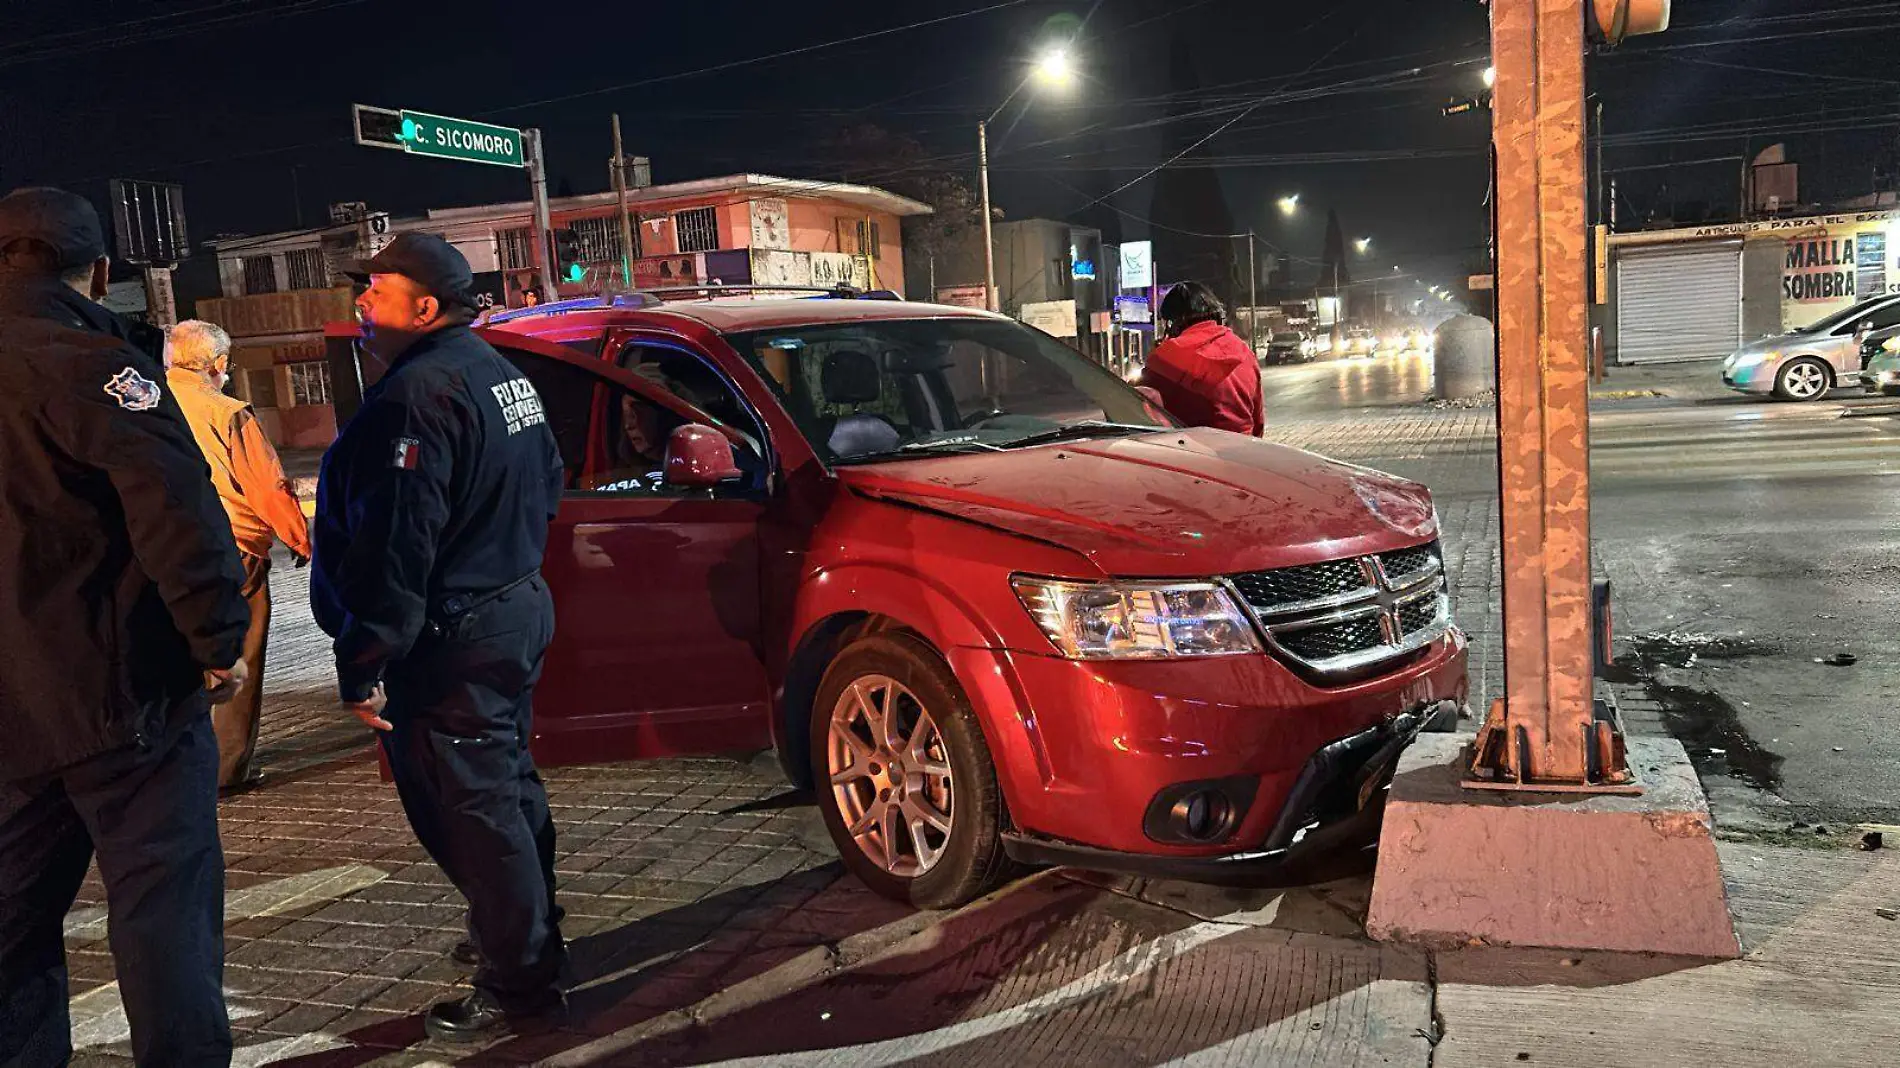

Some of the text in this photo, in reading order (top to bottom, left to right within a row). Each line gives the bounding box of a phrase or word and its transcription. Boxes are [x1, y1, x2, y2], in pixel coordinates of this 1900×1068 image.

[415, 123, 513, 156] C. SICOMORO
[1771, 217, 1817, 230] PARA
[1826, 216, 1844, 225] EL
[1786, 239, 1855, 268] MALLA
[1783, 271, 1855, 300] SOMBRA
